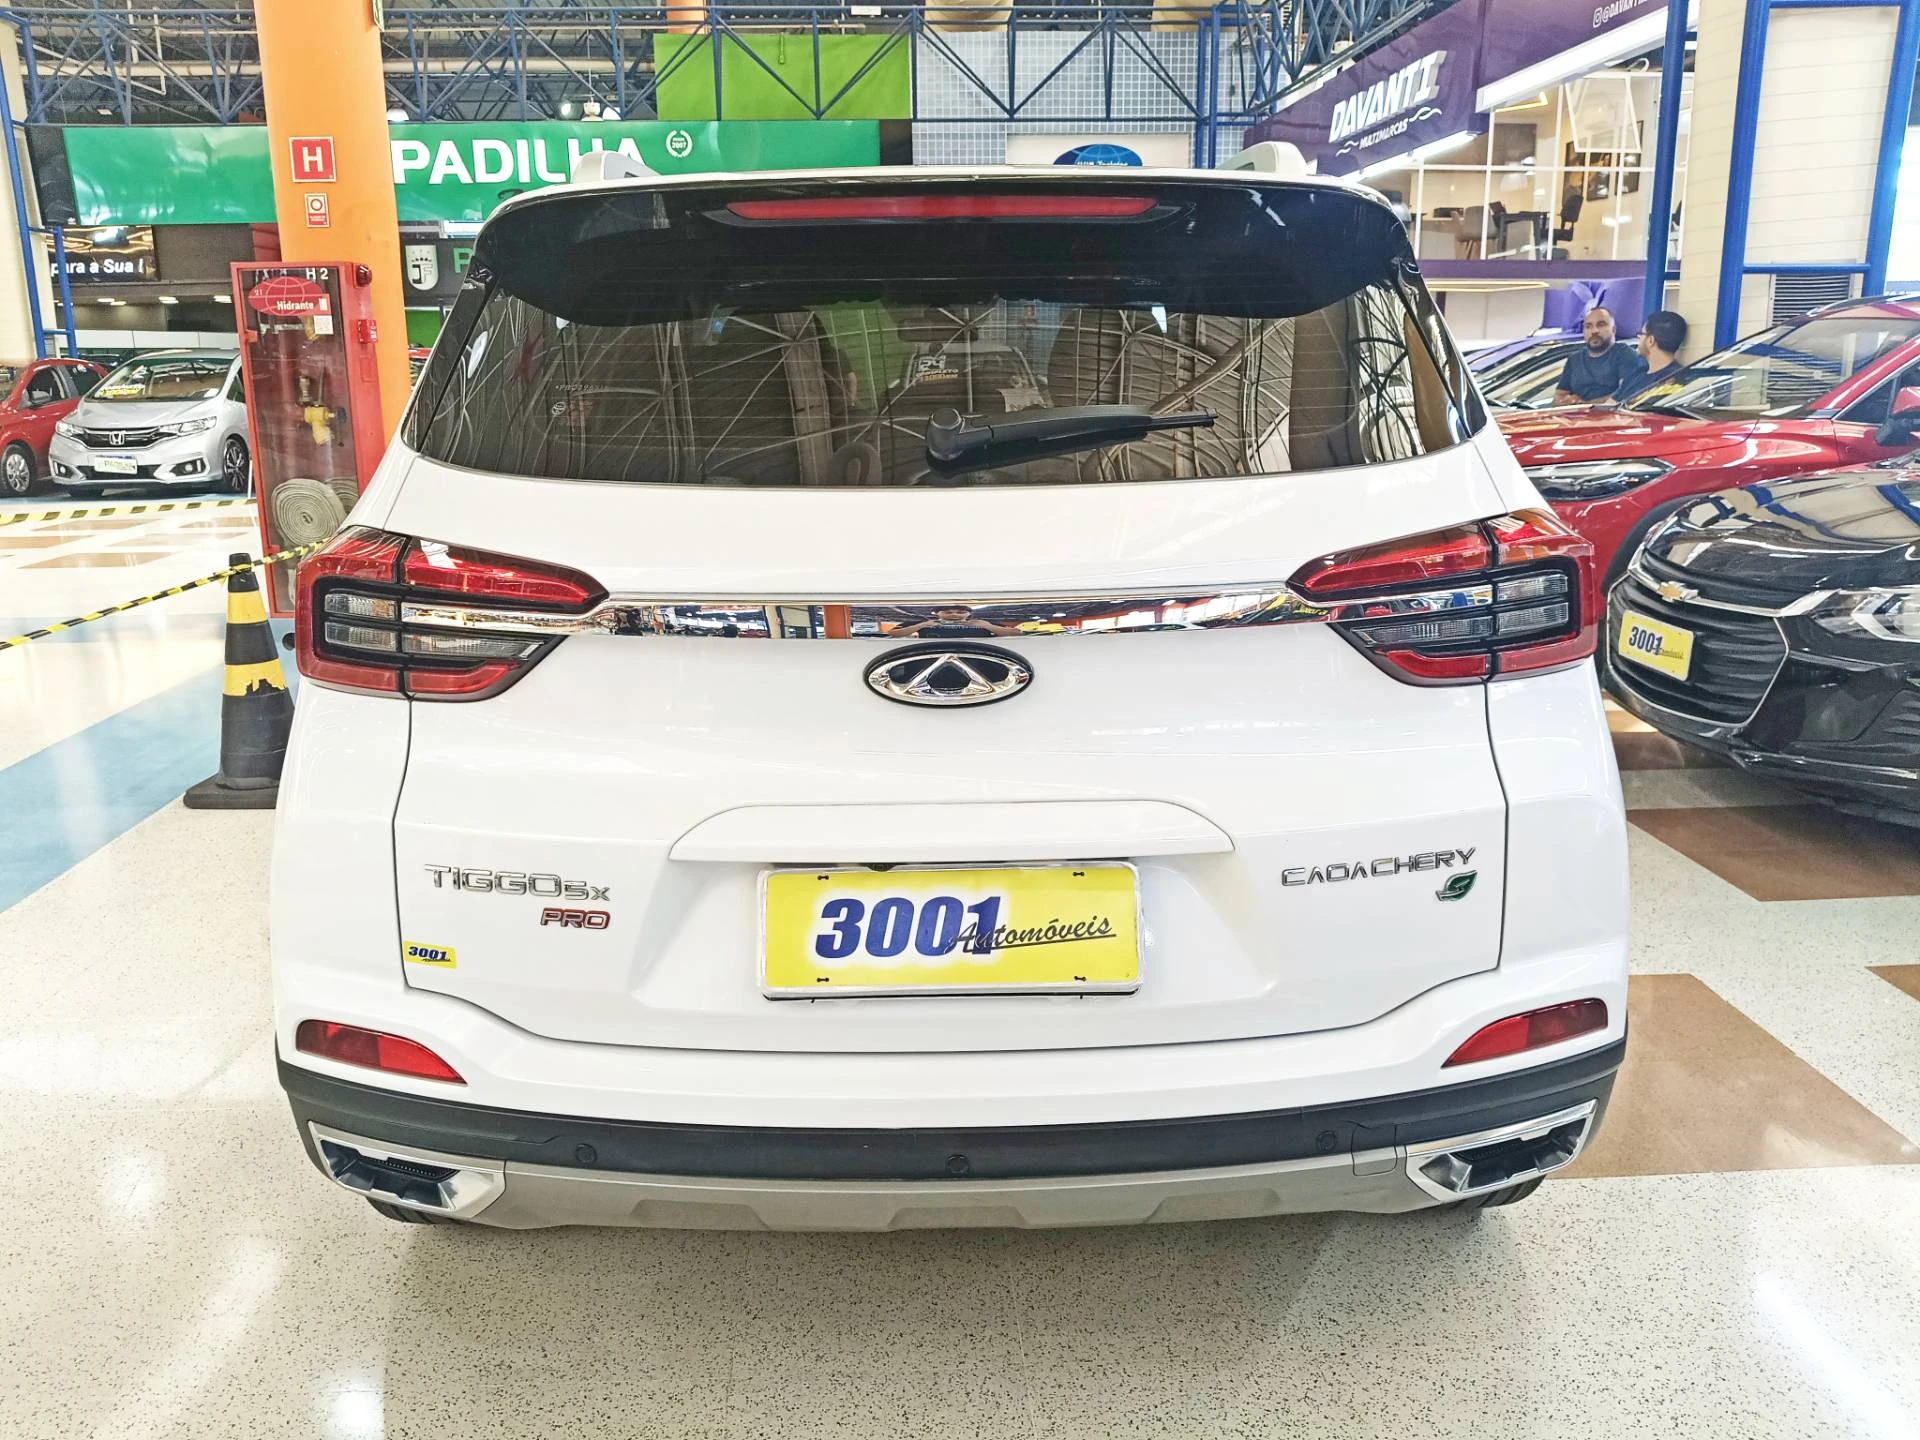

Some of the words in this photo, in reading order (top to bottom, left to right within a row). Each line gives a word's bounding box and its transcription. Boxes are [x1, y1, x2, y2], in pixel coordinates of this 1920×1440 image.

[1328, 50, 1446, 143] DAVANTI
[302, 147, 324, 172] H
[89, 263, 99, 273] a
[103, 259, 134, 273] Sua
[276, 300, 314, 311] Hidrante
[1629, 626, 1663, 656] 3001
[540, 907, 611, 930] PRO
[815, 896, 1001, 958] 3001
[945, 915, 1117, 953] Automóveis
[408, 946, 447, 961] 3001
